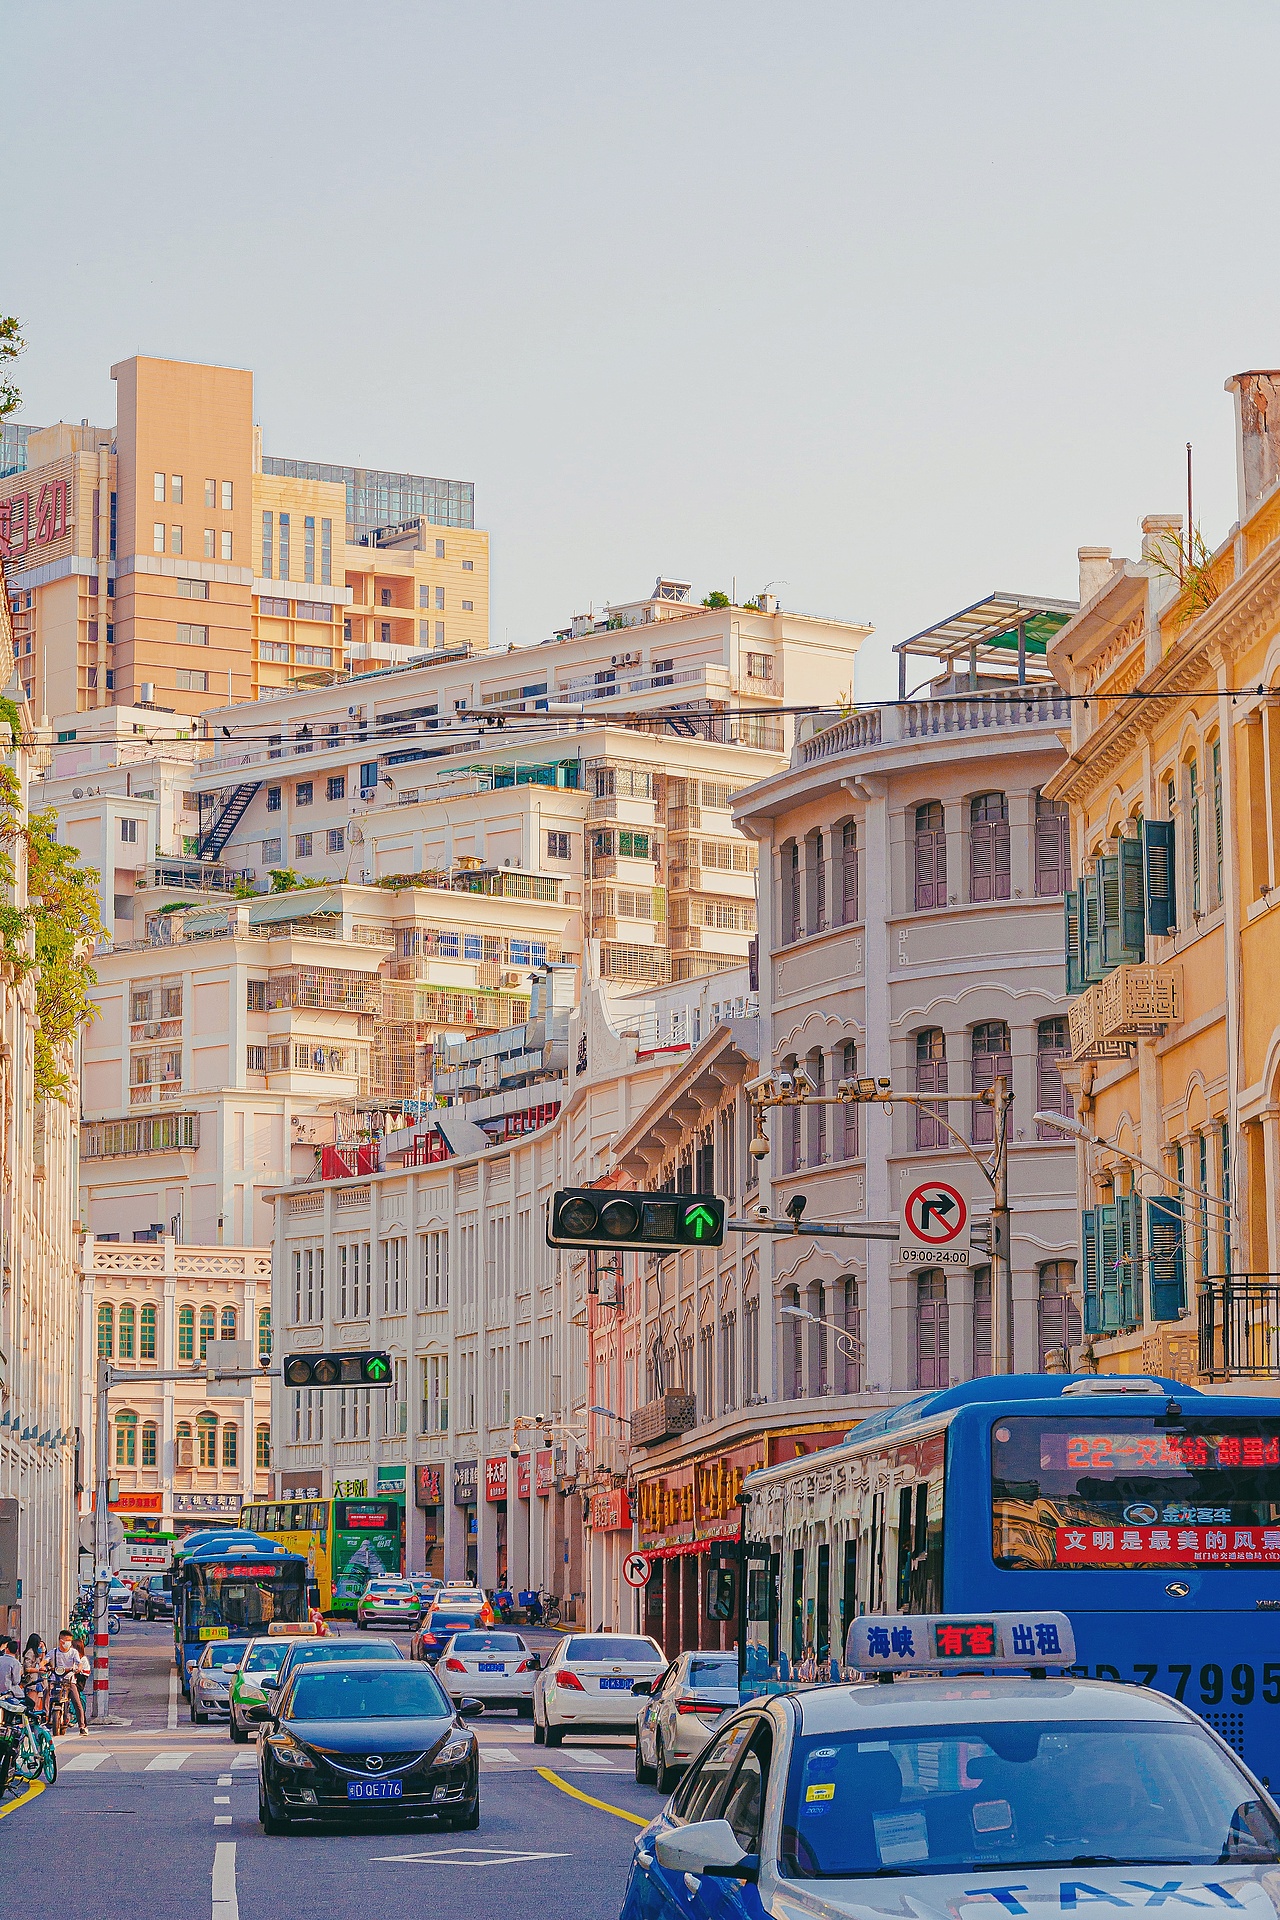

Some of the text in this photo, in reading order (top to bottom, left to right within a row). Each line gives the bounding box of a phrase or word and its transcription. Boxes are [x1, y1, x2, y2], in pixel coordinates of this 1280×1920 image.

[902, 1250, 967, 1263] 09:00-24:00
[179, 1496, 237, 1506] 手机专卖店
[1162, 1507, 1232, 1523] 金龙客车
[1065, 1531, 1280, 1551] 文明是最美的风景
[867, 1623, 1063, 1658] 海峡 有客 出租
[964, 1881, 1248, 1916] TAXI
